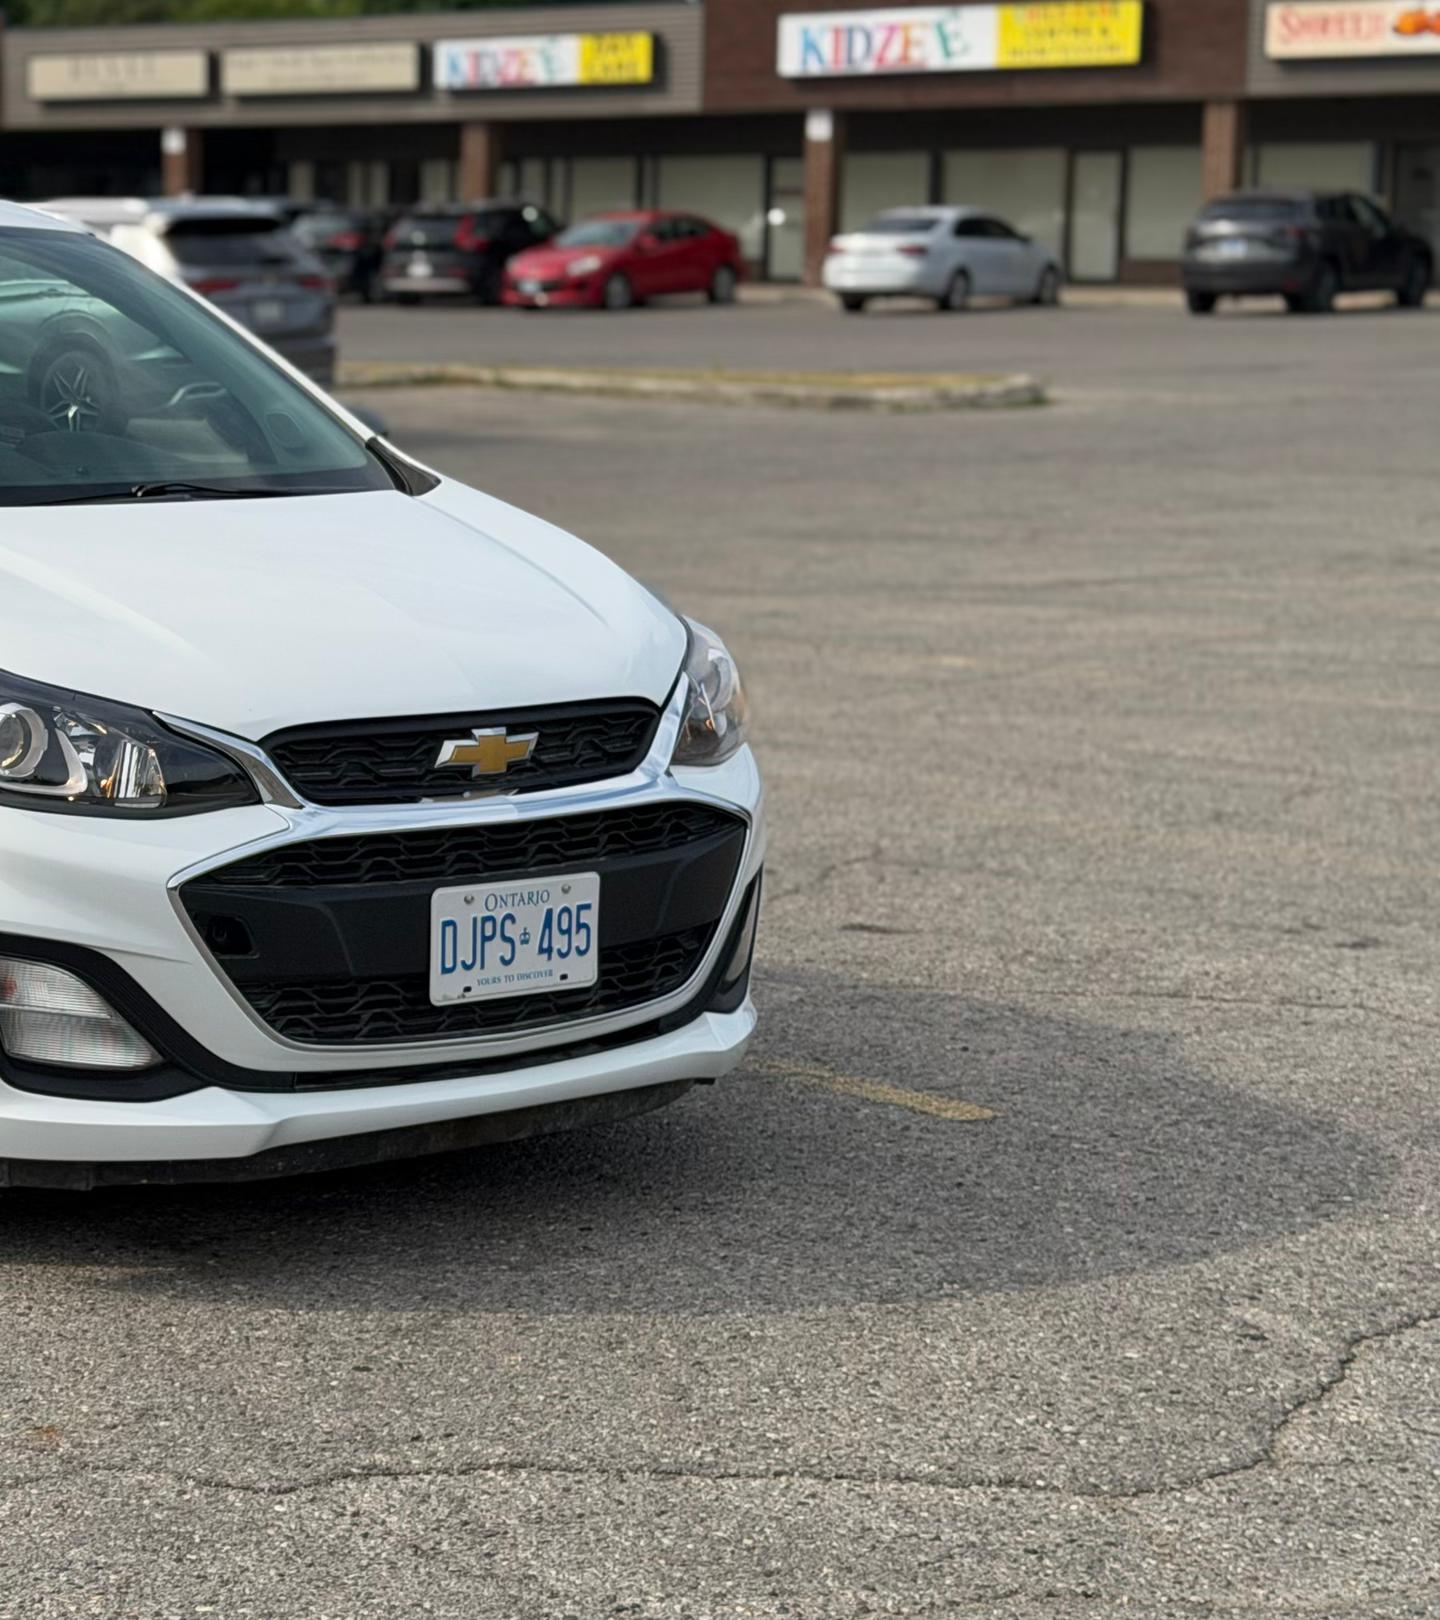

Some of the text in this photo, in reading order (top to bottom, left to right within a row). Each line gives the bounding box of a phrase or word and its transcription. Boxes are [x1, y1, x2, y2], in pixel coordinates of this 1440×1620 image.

[800, 10, 969, 68] KIDZEE
[440, 903, 592, 975] DJPS 495
[476, 969, 554, 986] YOURS TO DISCOVER
